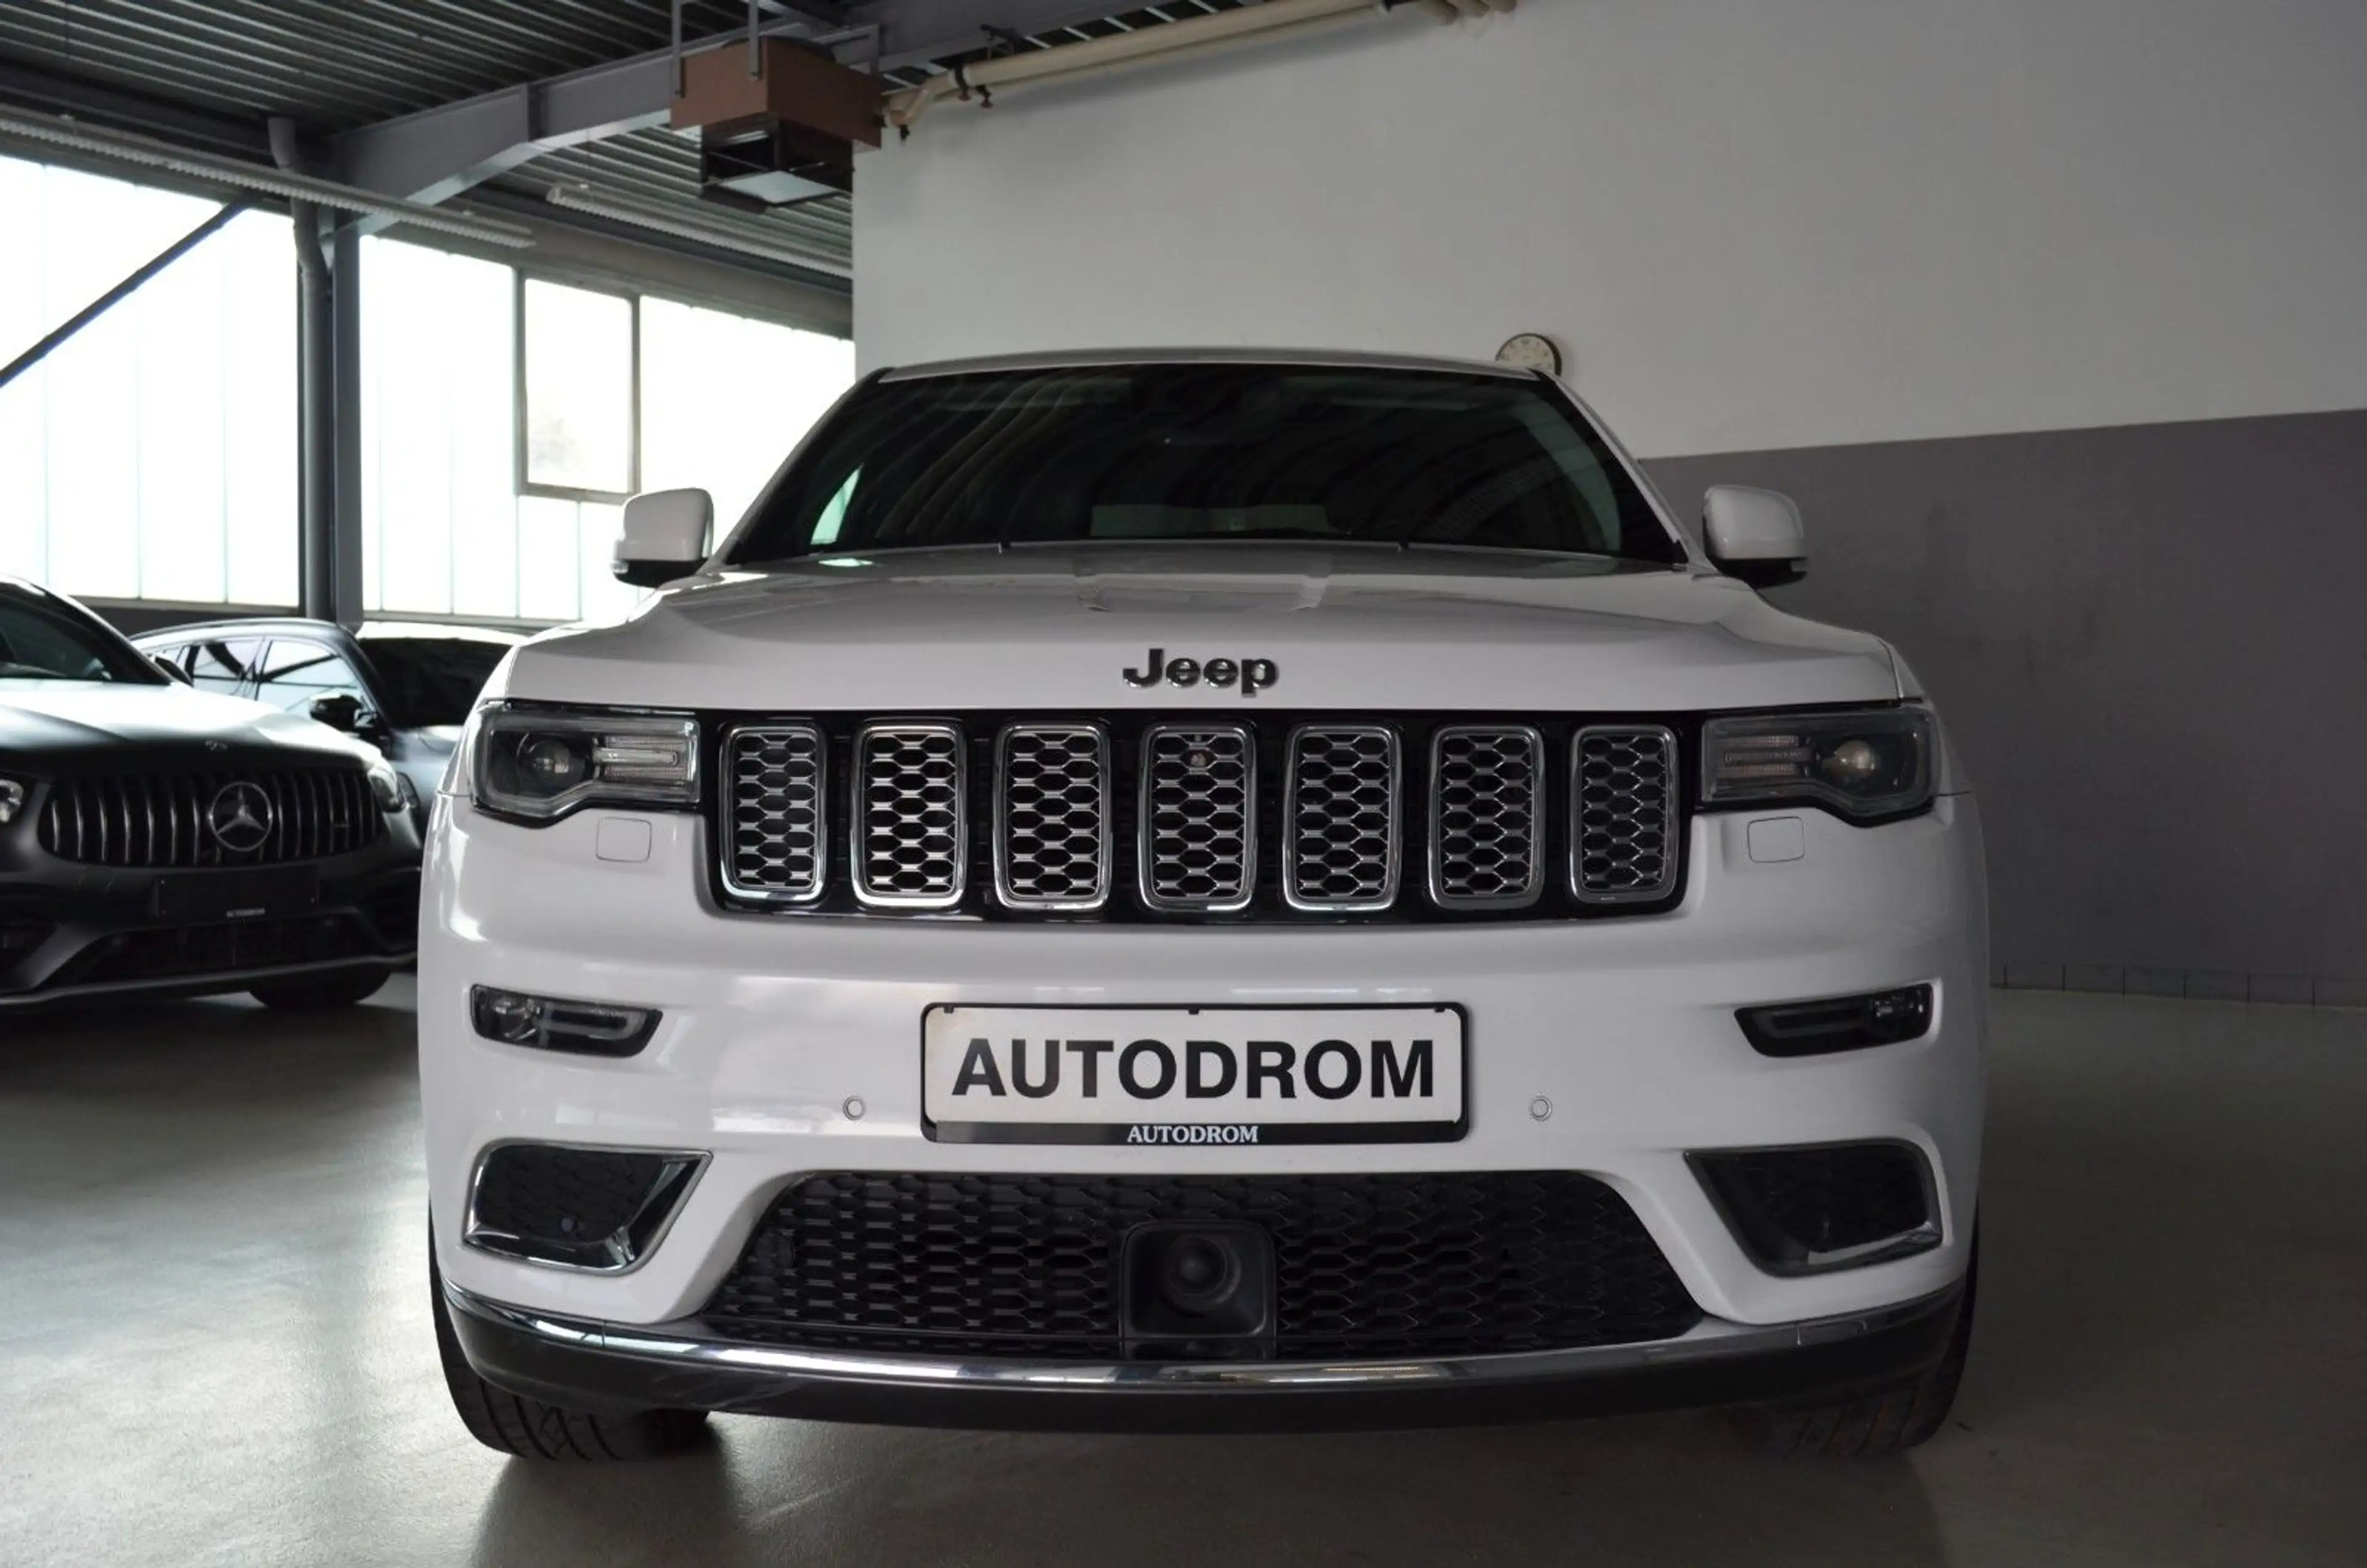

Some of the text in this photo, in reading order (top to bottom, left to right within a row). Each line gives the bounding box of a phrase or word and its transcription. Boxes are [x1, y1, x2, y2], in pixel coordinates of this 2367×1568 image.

[1122, 648, 1279, 697] Jeep
[952, 1039, 1433, 1100] AUTODROM
[1127, 1125, 1259, 1143] AUTODROM
